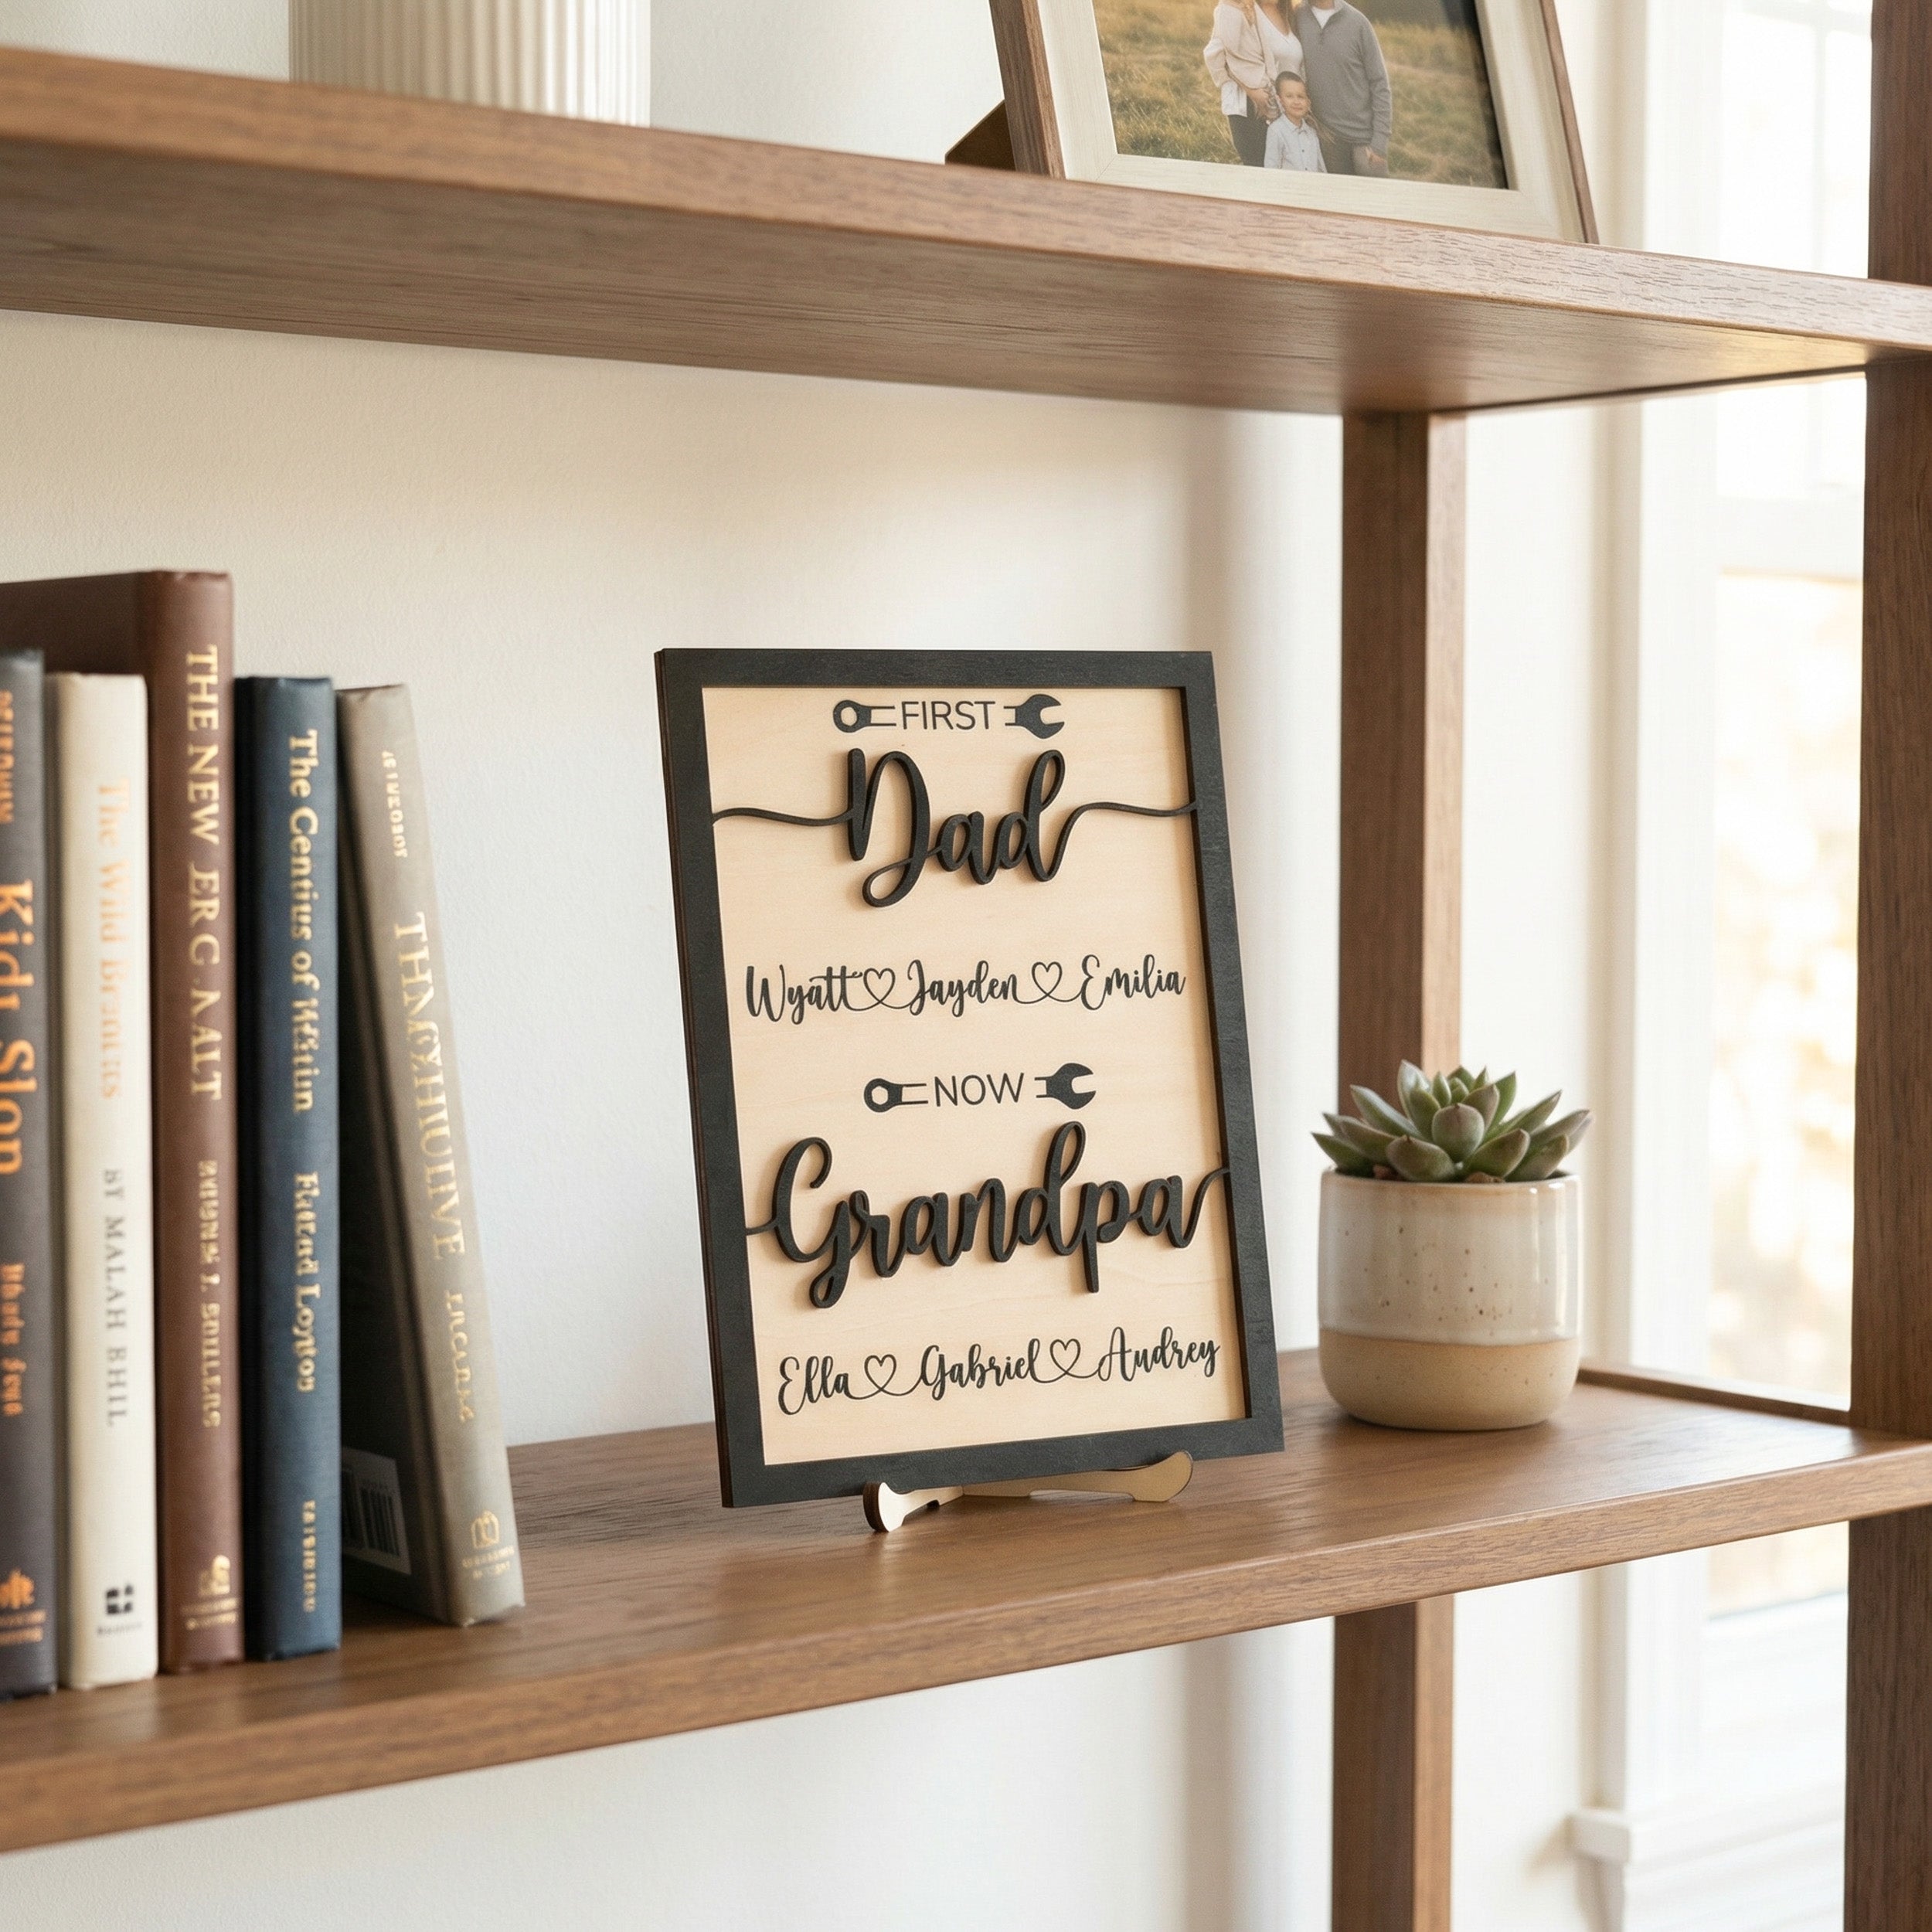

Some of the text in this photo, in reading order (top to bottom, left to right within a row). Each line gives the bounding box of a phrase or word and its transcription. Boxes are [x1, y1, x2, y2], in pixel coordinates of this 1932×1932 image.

[185, 644, 219, 733] THE
[902, 700, 996, 731] FIRST
[186, 743, 220, 845] NEW
[289, 729, 319, 798] The
[97, 777, 131, 847] The
[847, 748, 1083, 907] Dad
[291, 951, 321, 992] of
[746, 954, 1186, 1025] Wyatt Jayden Emilia
[934, 1072, 1025, 1107] NOW
[105, 1168, 124, 1200] BY
[771, 1121, 1207, 1308] Grandpa
[105, 1216, 128, 1331] MALAH
[777, 1326, 1221, 1416] Ella Gabriel Audrey
